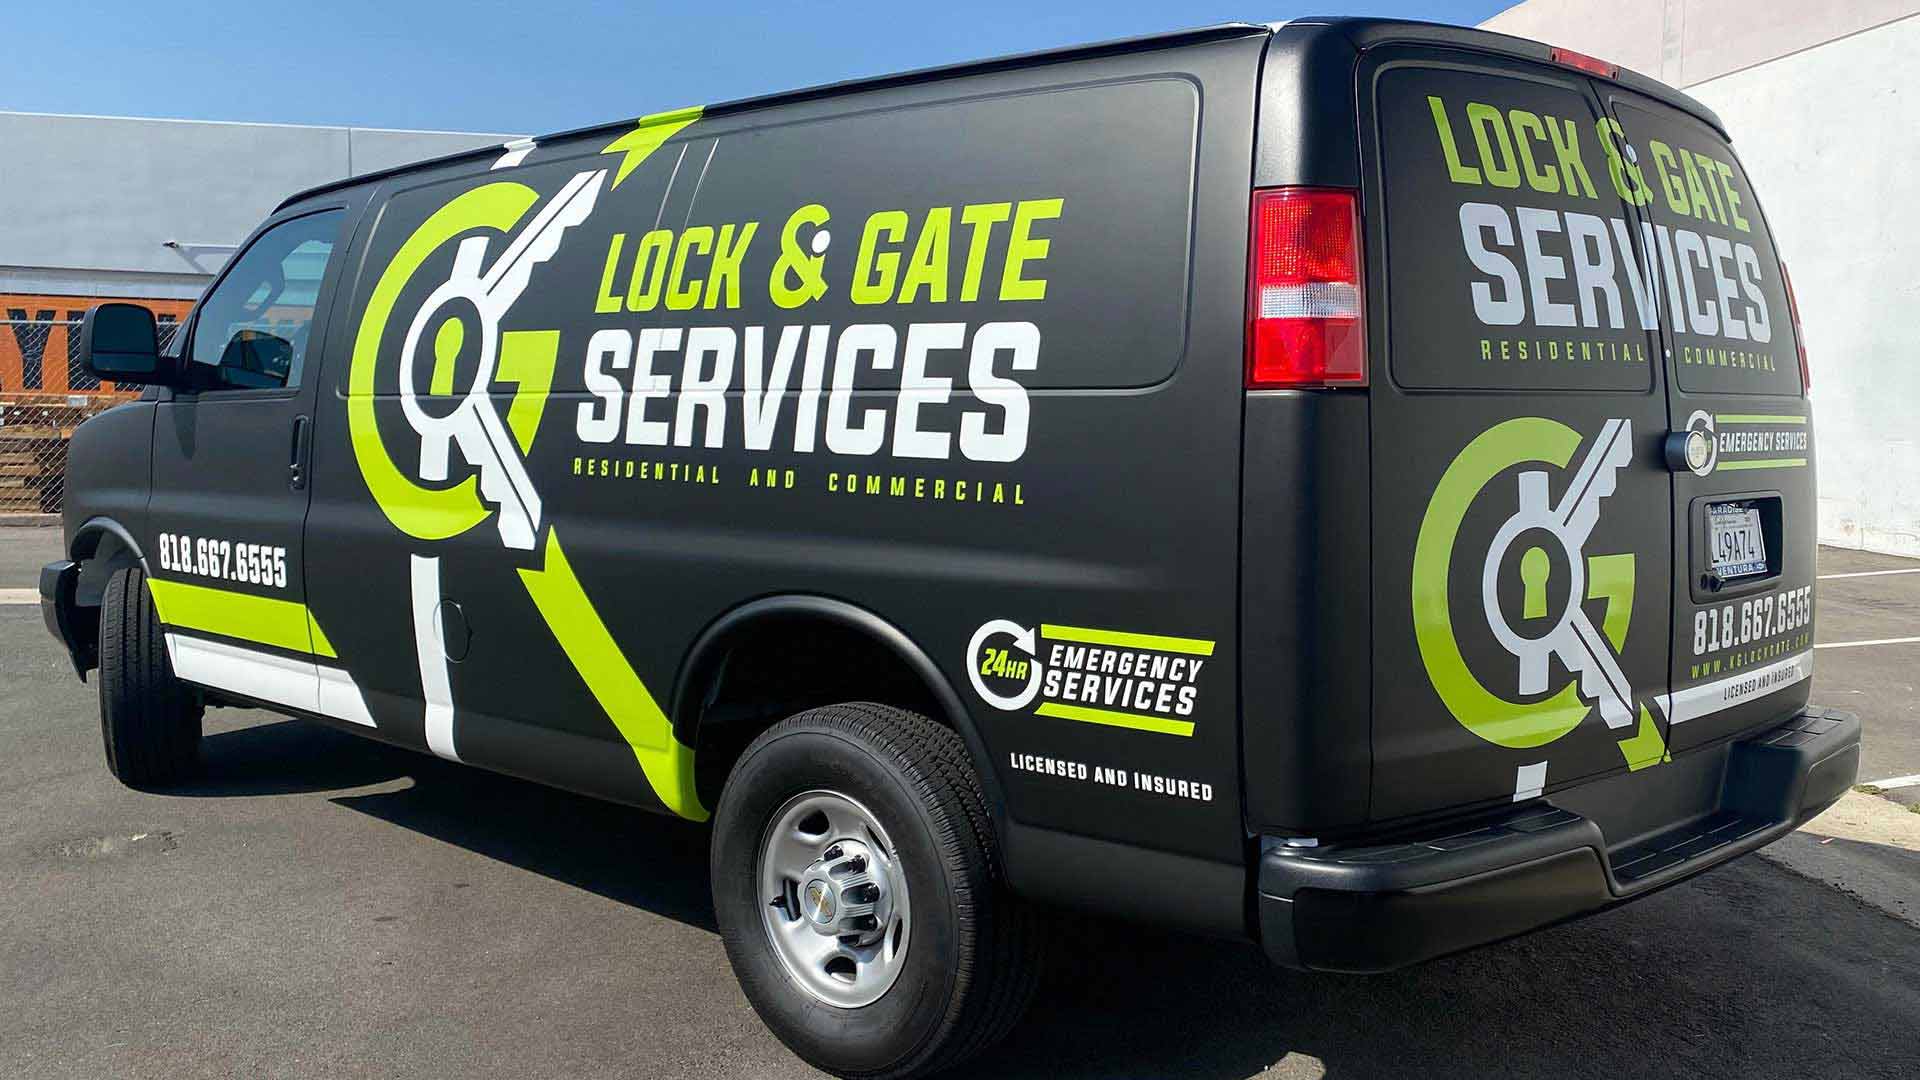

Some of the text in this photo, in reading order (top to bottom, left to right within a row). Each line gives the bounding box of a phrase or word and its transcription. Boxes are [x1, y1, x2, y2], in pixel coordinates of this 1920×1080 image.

[1427, 95, 1750, 233] LOCK & GATE
[595, 198, 1065, 314] LOCK & GATE
[1459, 200, 1772, 345] SERVICES
[1480, 339, 1776, 373] RESIDENTIAL COMMERCIAL
[576, 321, 1041, 463] SERVICES
[1719, 432, 1774, 453] EMERGENCY
[1775, 432, 1807, 451] SERVICES
[574, 457, 1025, 505] RESIDENTIAL AND COMMERCIAL
[159, 532, 287, 589] 818.667.6555
[1717, 563, 1754, 577] VENTURA
[1693, 584, 1811, 656] 818.667.6555
[981, 648, 1028, 680] 24HR
[1049, 644, 1203, 683] EMERGENCY
[1723, 664, 1795, 701] LICENSED AND INSURED
[1043, 669, 1197, 716] SERVICES
[1010, 752, 1213, 802] LICENSED AND INSURED
